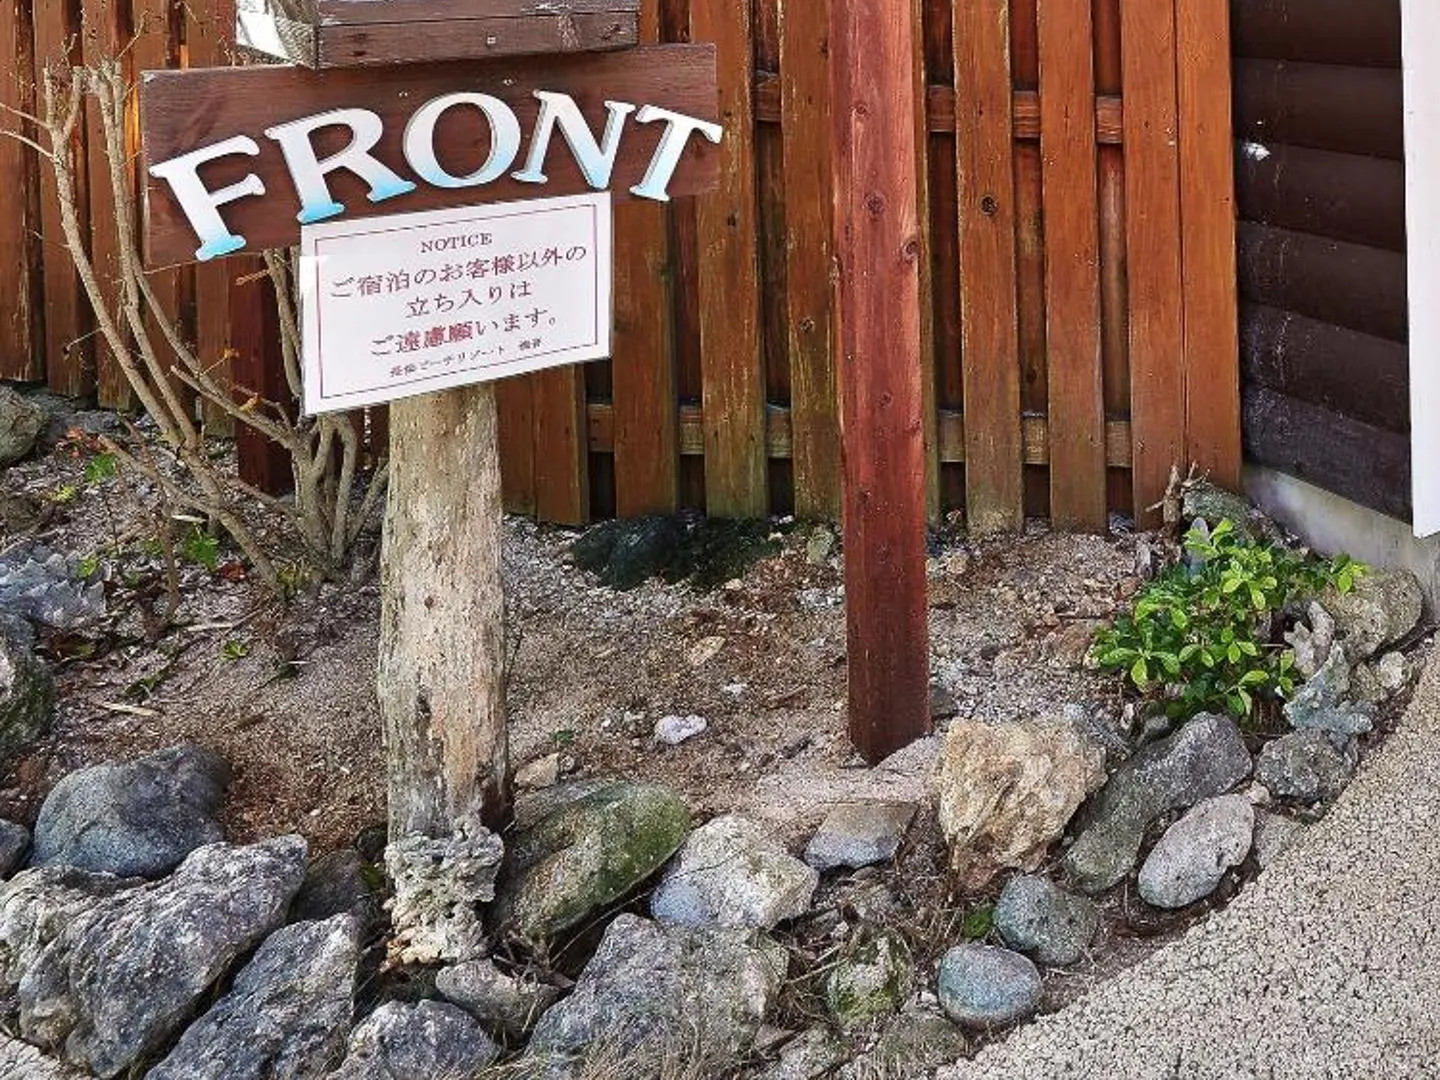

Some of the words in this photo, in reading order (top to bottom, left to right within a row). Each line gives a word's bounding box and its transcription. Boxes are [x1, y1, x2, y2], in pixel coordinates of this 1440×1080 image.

[148, 90, 722, 261] FRONT
[420, 232, 493, 254] NOTICE
[330, 244, 587, 298] ご宿泊のお客様以外の
[404, 280, 532, 319] 立ち入りは
[370, 307, 557, 356] ご遠慮願います。
